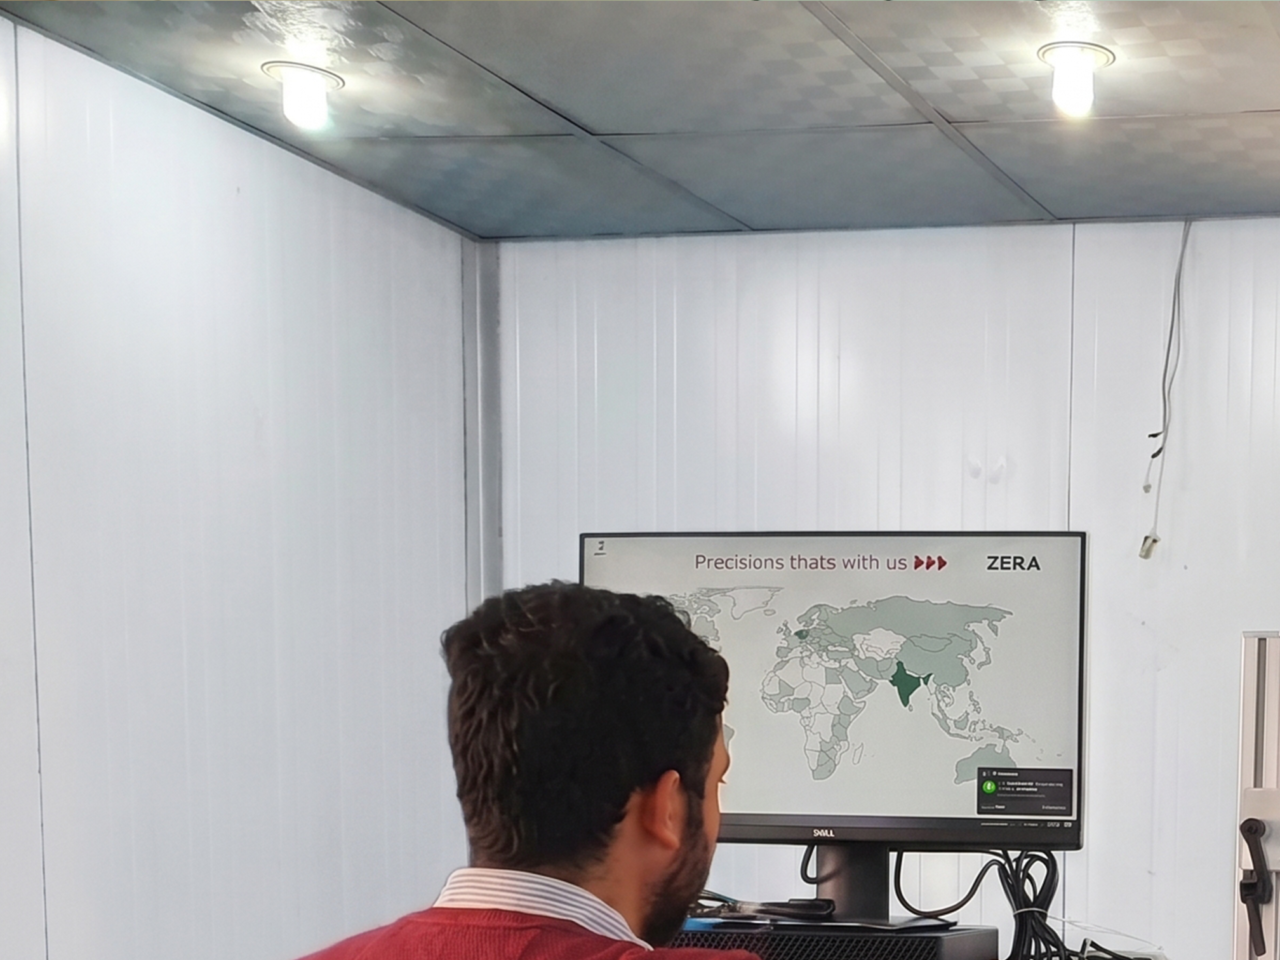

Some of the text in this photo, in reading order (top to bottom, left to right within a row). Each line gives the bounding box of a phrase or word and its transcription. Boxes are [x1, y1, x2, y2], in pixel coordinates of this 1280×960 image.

[695, 554, 907, 570] Precisions thats with us
[987, 556, 1041, 570] ZERA
